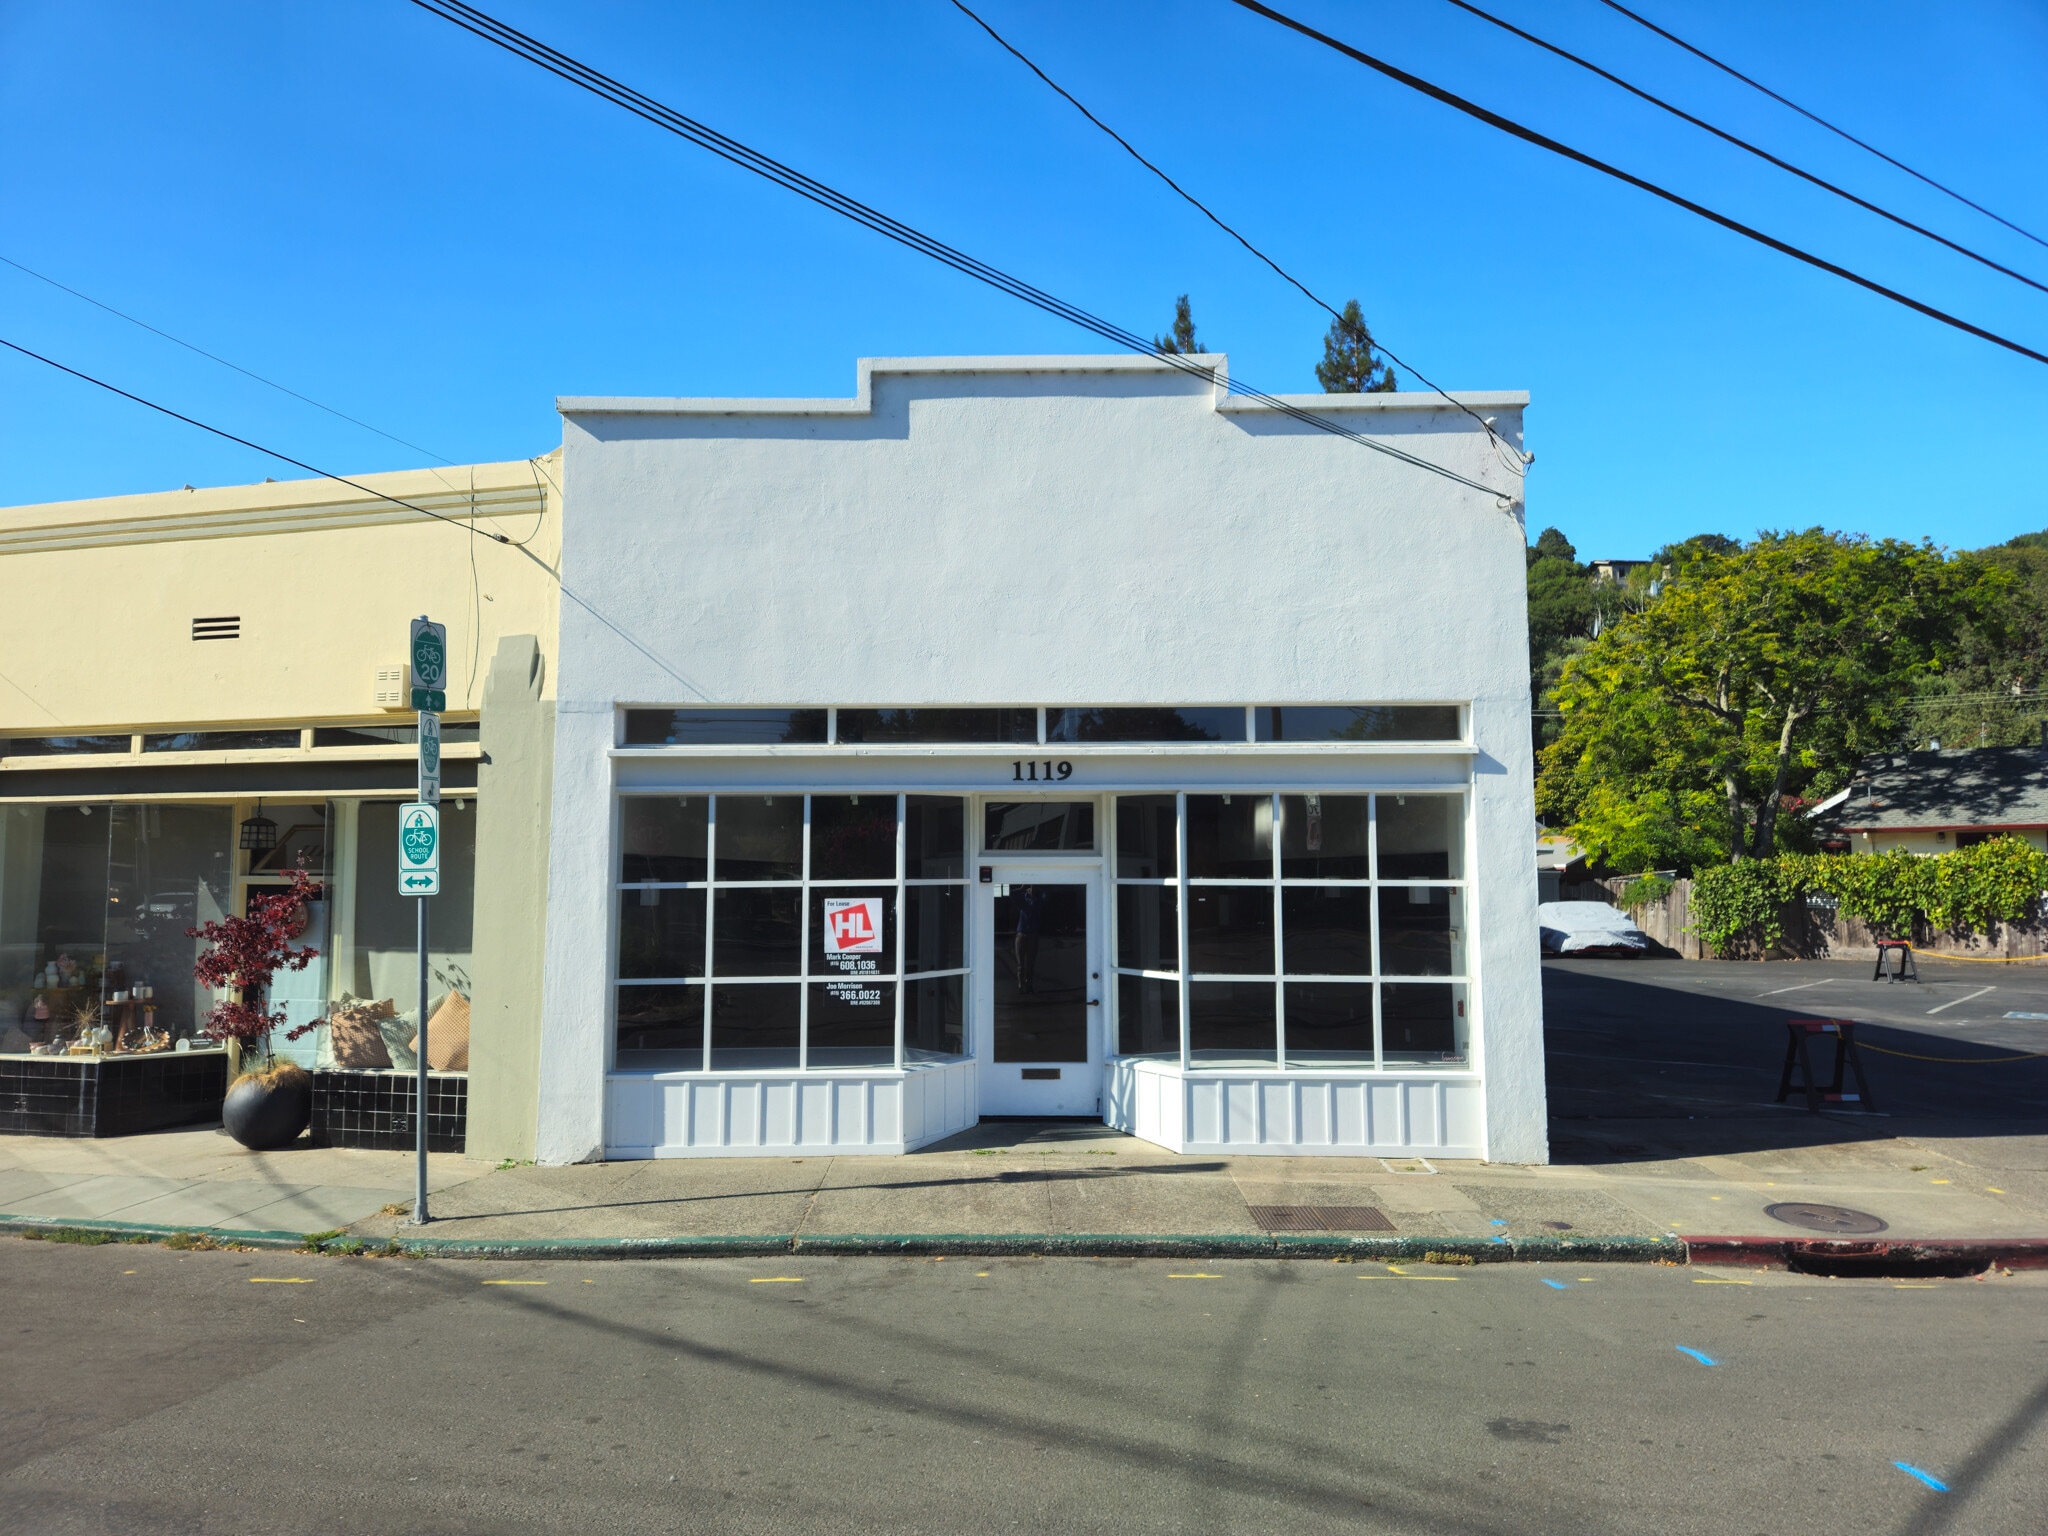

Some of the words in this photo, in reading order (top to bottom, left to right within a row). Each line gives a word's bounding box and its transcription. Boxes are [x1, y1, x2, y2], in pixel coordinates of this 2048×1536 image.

[421, 663, 439, 681] 20
[1012, 760, 1073, 781] 1119
[835, 912, 874, 938] HL
[842, 953, 861, 961] Cooper
[840, 960, 876, 970] 608.1036
[826, 982, 837, 990] Joe
[838, 982, 863, 990] Morrison
[840, 990, 880, 1000] 366.0022
